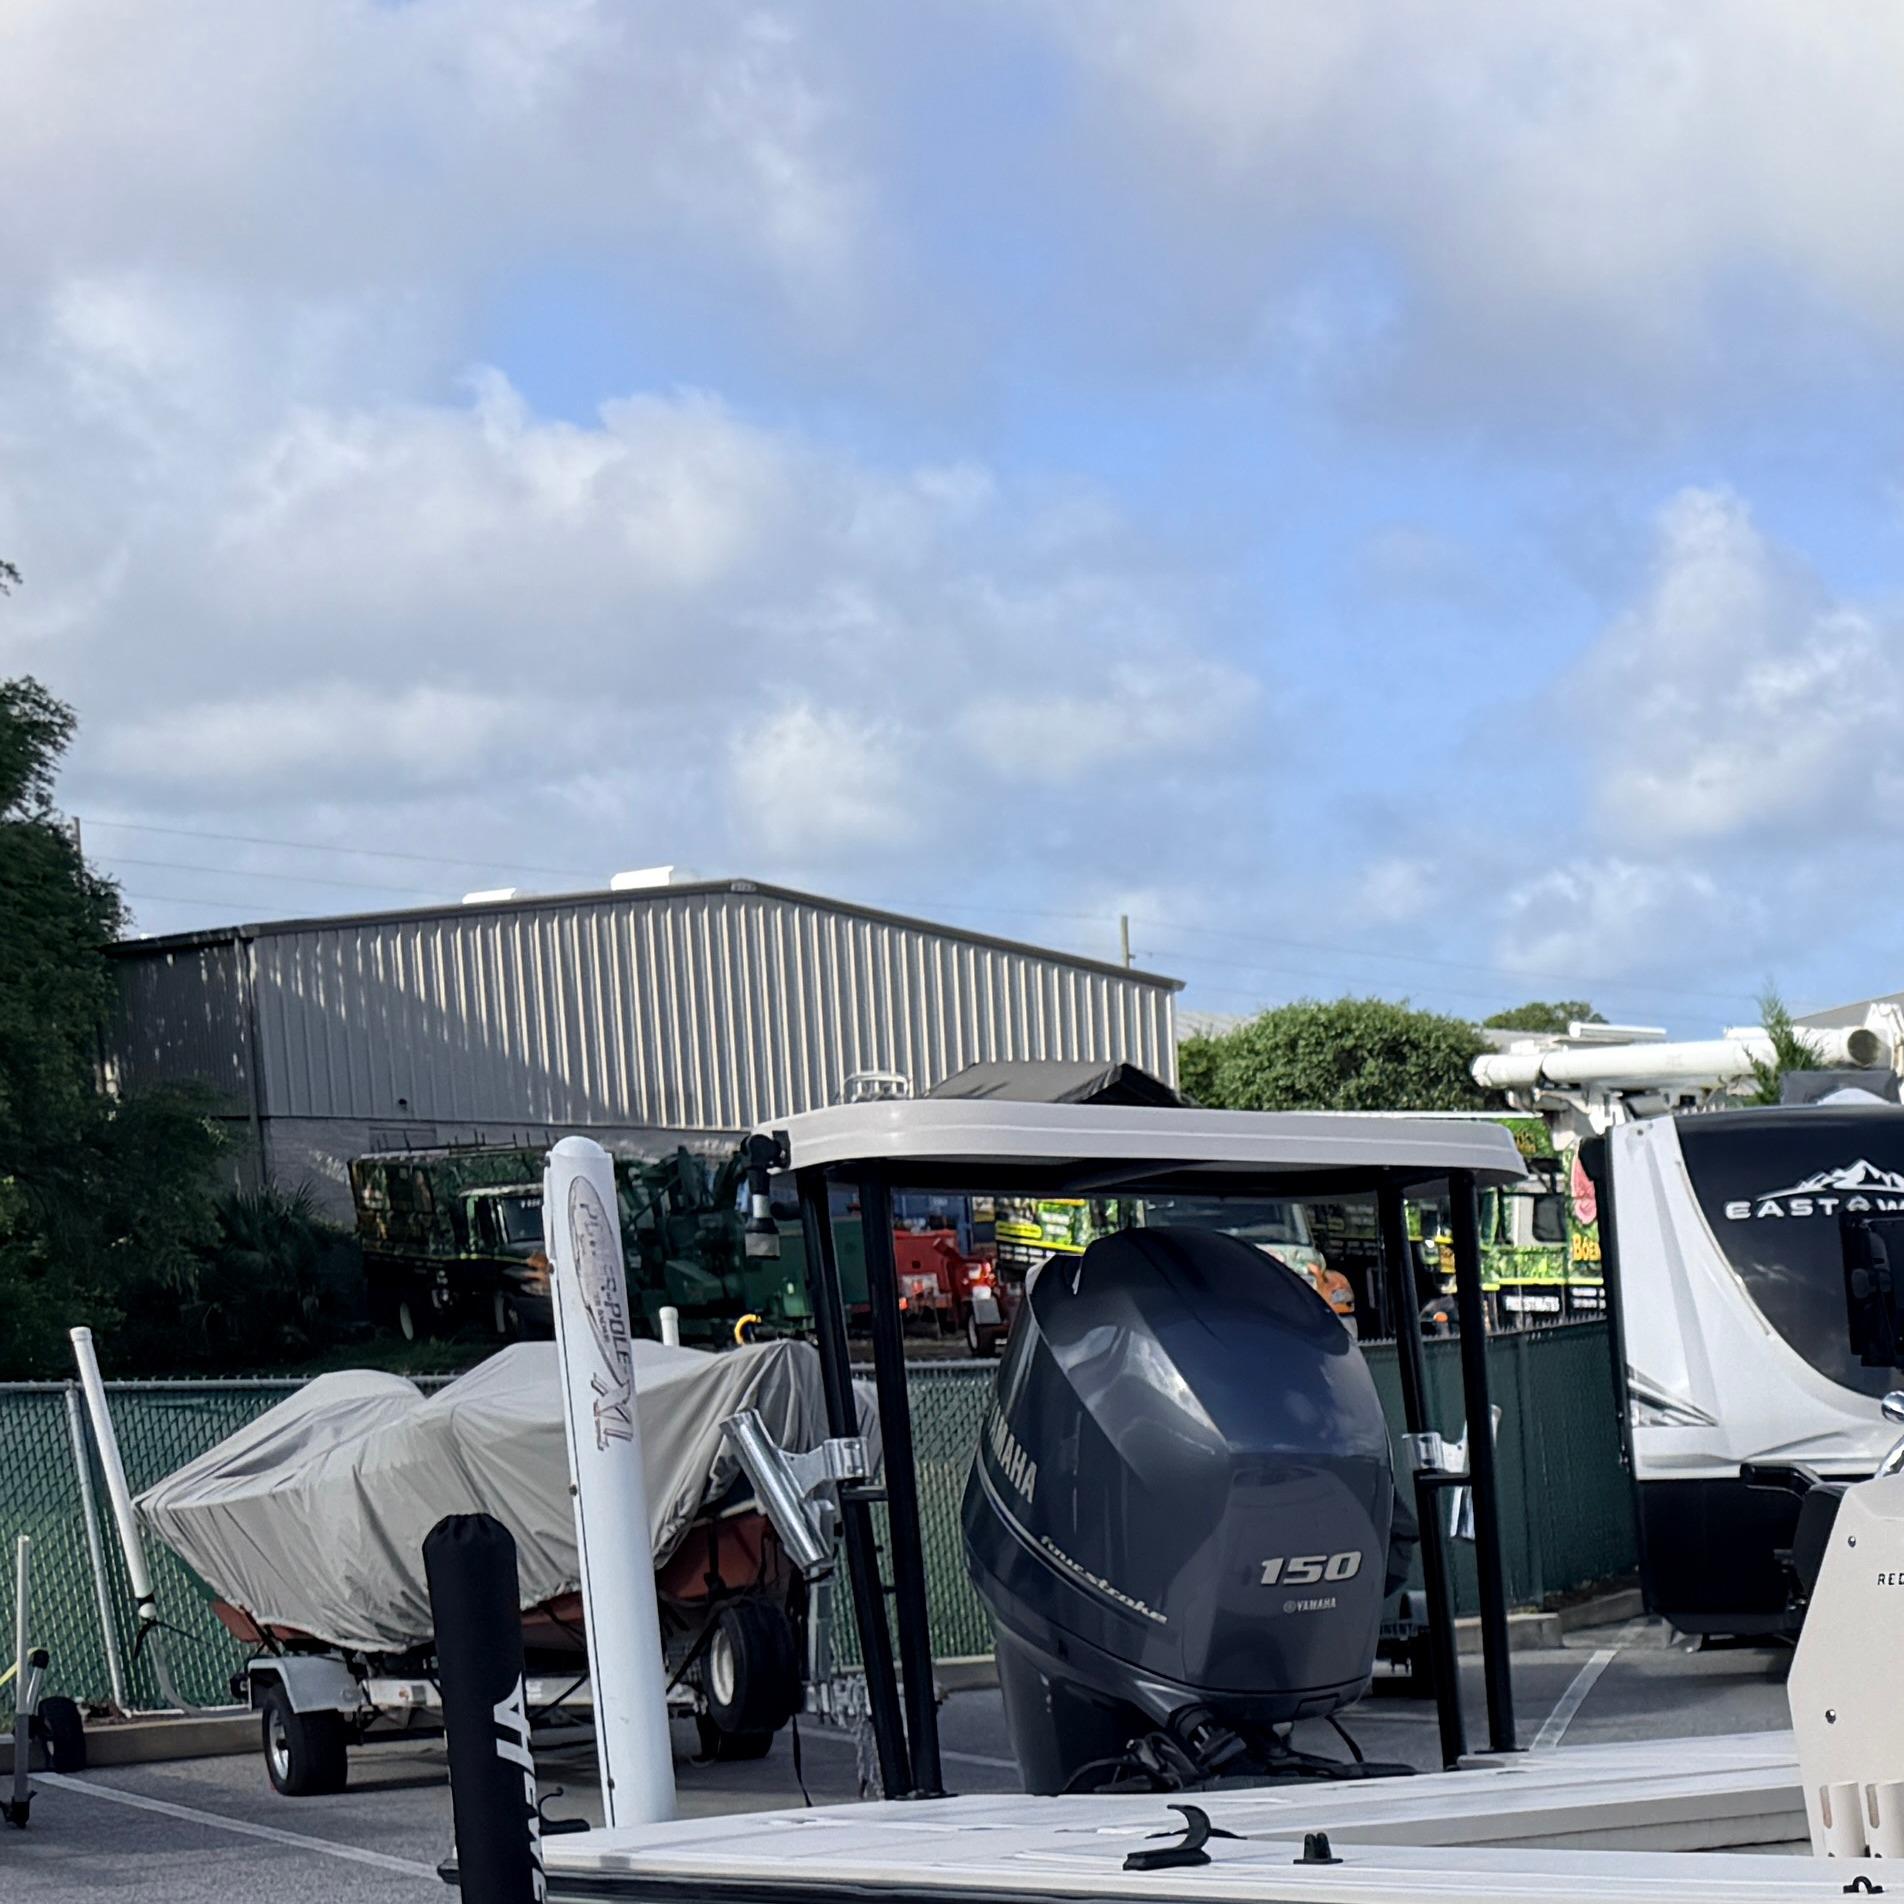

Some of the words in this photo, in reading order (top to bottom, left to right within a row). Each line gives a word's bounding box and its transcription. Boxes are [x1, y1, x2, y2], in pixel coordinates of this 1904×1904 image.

[1725, 1198, 1839, 1220] EAST
[1260, 1551, 1362, 1586] 150
[1297, 1597, 1336, 1611] YAMAHA
